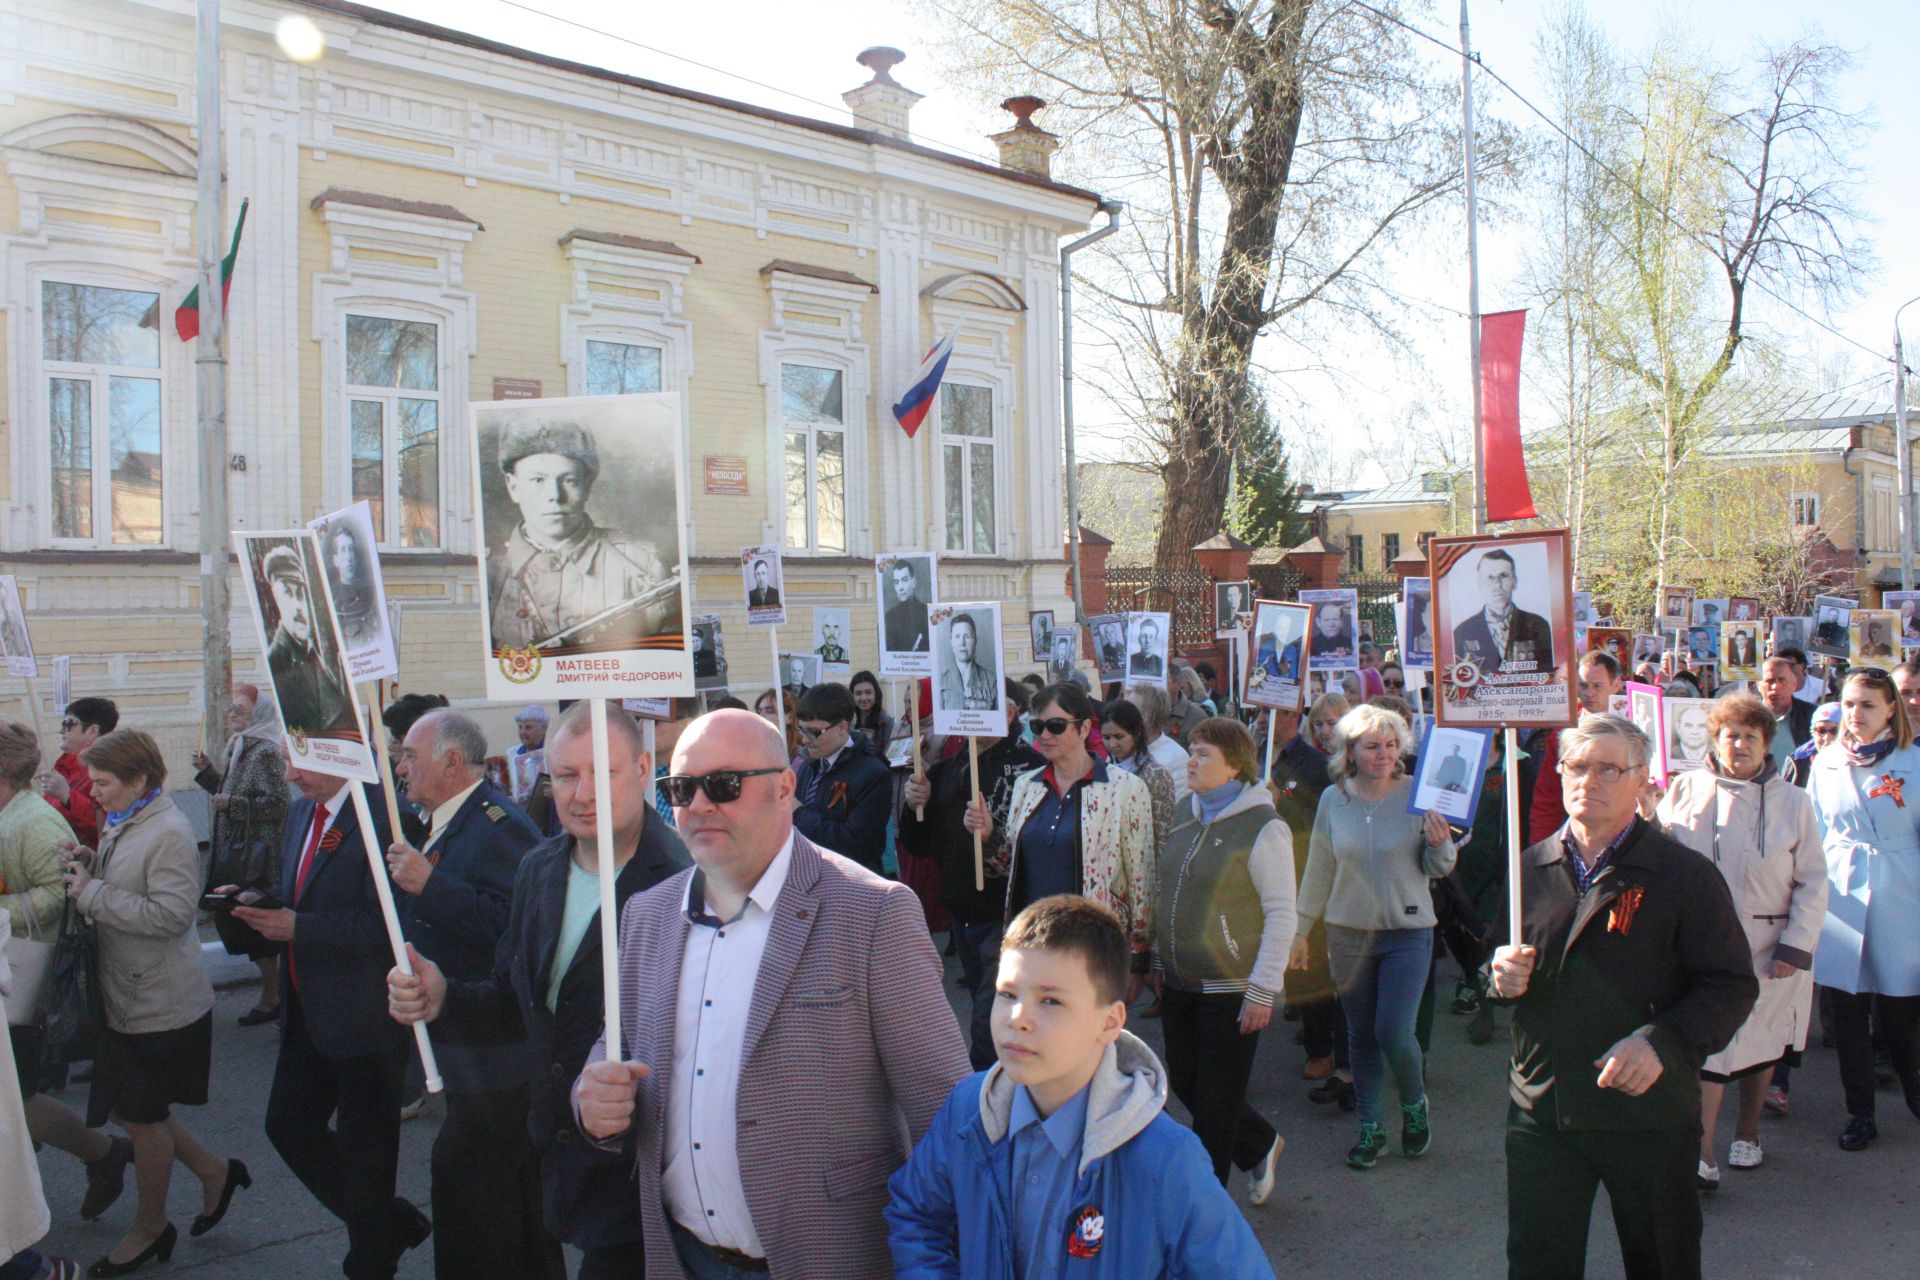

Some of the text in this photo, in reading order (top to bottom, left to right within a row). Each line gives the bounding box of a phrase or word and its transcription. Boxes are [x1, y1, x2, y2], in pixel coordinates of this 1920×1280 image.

[556, 660, 620, 671] МАТВЕЕВ
[1500, 661, 1537, 672] Лукин
[556, 672, 682, 684] ДМИТРИЙ ФЕДОРОВИЧ
[1486, 673, 1548, 684] Александр
[1475, 685, 1564, 696] Александрович
